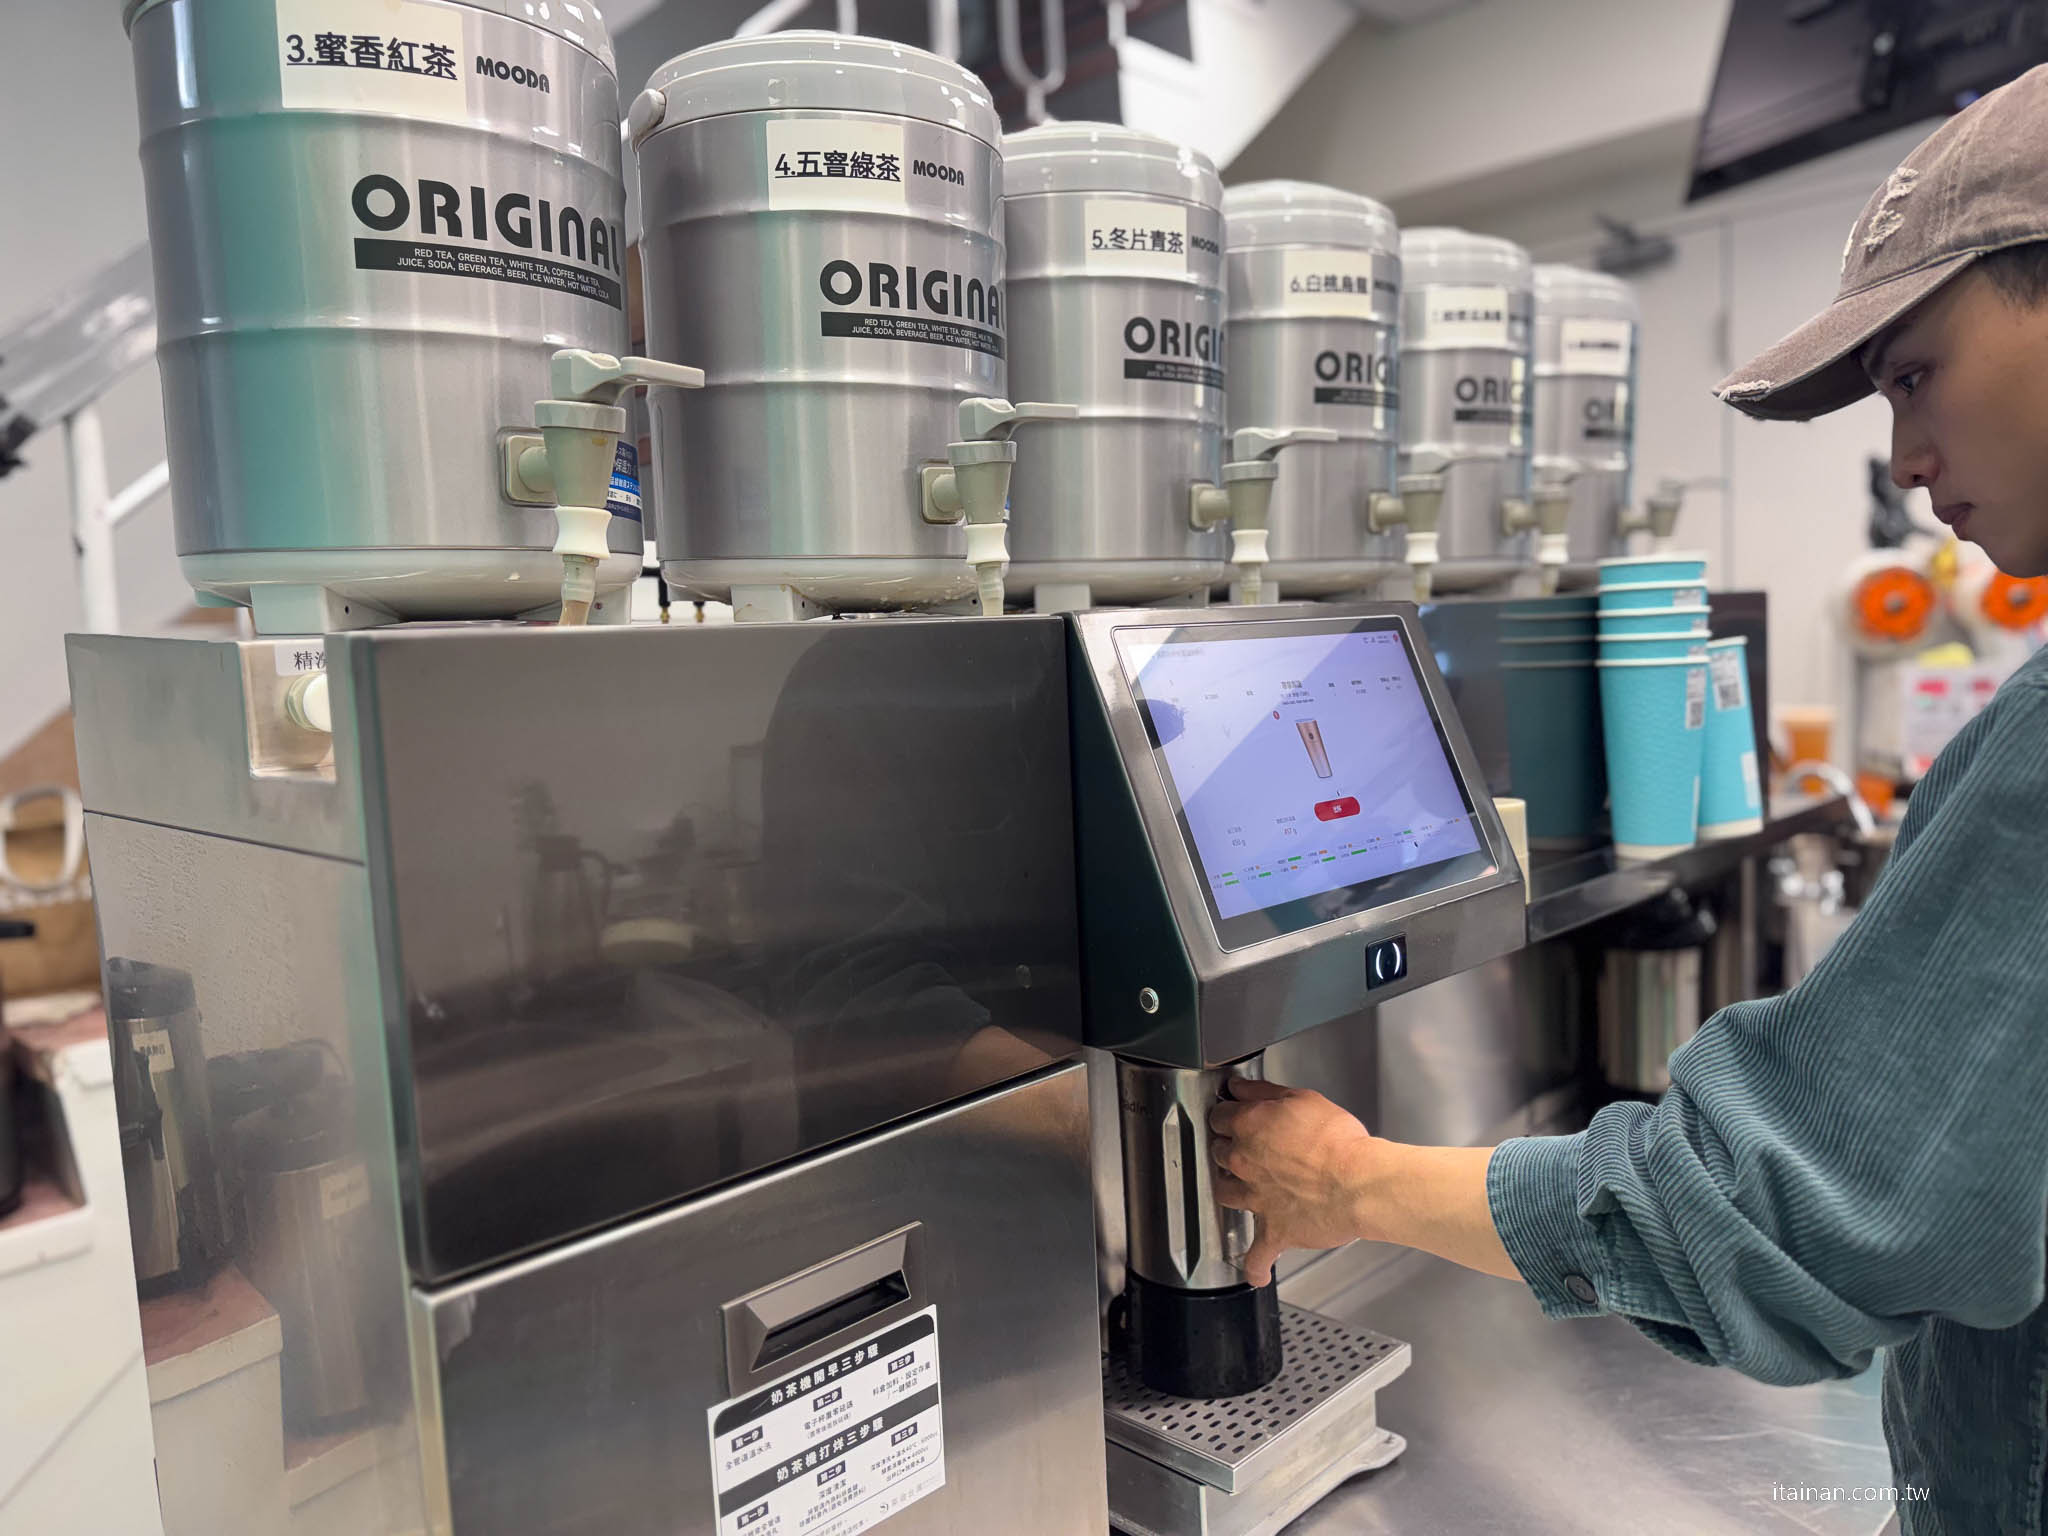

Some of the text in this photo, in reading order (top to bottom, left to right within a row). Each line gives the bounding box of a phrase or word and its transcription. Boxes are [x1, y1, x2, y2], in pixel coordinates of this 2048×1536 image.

[286, 31, 458, 80] 3.蜜香紅茶
[475, 55, 551, 94] MOODA
[912, 159, 965, 187] MOODA
[351, 174, 621, 276] ORIGINAL
[1092, 227, 1184, 254] 5.冬片青茶
[397, 257, 426, 269] JUICE,
[428, 260, 455, 271] SODA,
[458, 263, 505, 278] BEVERAGE,
[506, 269, 528, 281] BEER,
[530, 272, 542, 282] ICE
[544, 275, 567, 288] WATER,
[567, 280, 579, 291] HOT
[414, 248, 433, 258] RED
[435, 250, 455, 261] TEA,
[458, 252, 487, 264] GREEN
[489, 256, 507, 267] TEA,
[509, 259, 534, 272] WHITE
[535, 264, 550, 275] TEA,
[551, 267, 576, 281] COFFEE,
[852, 326, 873, 335] JUICE,
[873, 327, 895, 336] SODA,
[896, 329, 928, 339] BEVERAGE,
[864, 318, 878, 326] RED
[880, 319, 895, 328] TEA,
[896, 321, 917, 330] GREEN
[918, 323, 931, 332] TEA,
[931, 324, 949, 334] WHITE
